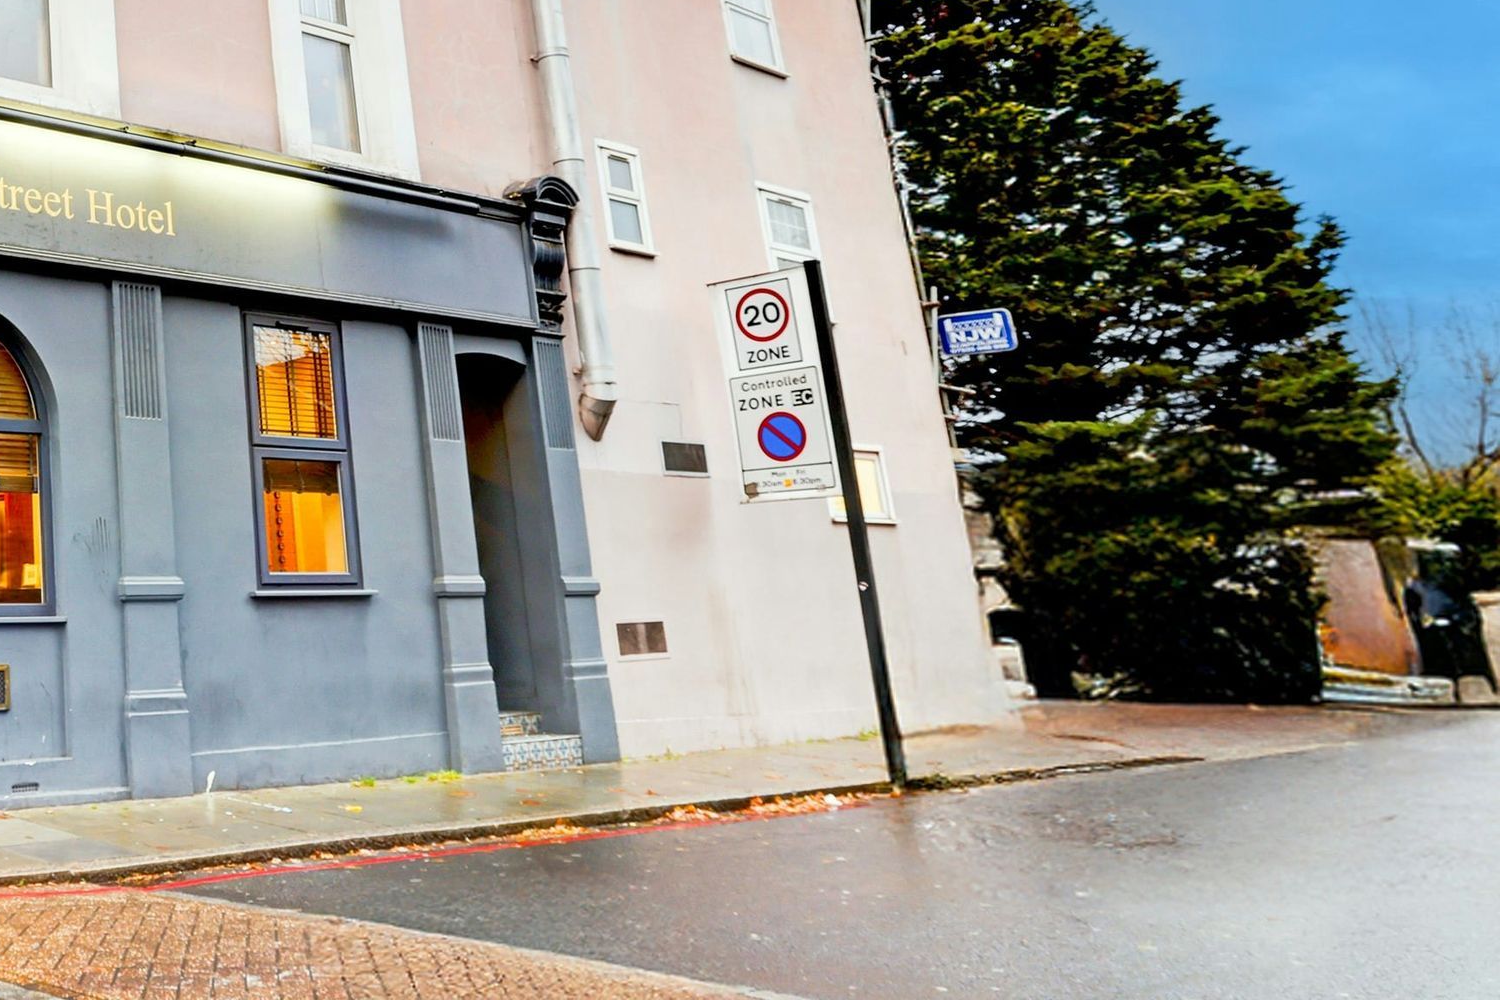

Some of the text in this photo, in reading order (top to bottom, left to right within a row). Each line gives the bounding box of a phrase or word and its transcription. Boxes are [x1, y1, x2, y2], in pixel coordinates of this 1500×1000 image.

[84, 188, 176, 236] Hotel
[744, 301, 780, 327] 20
[746, 345, 791, 363] ZONE
[741, 374, 808, 392] Controlled
[738, 388, 815, 411] ZONE EC
